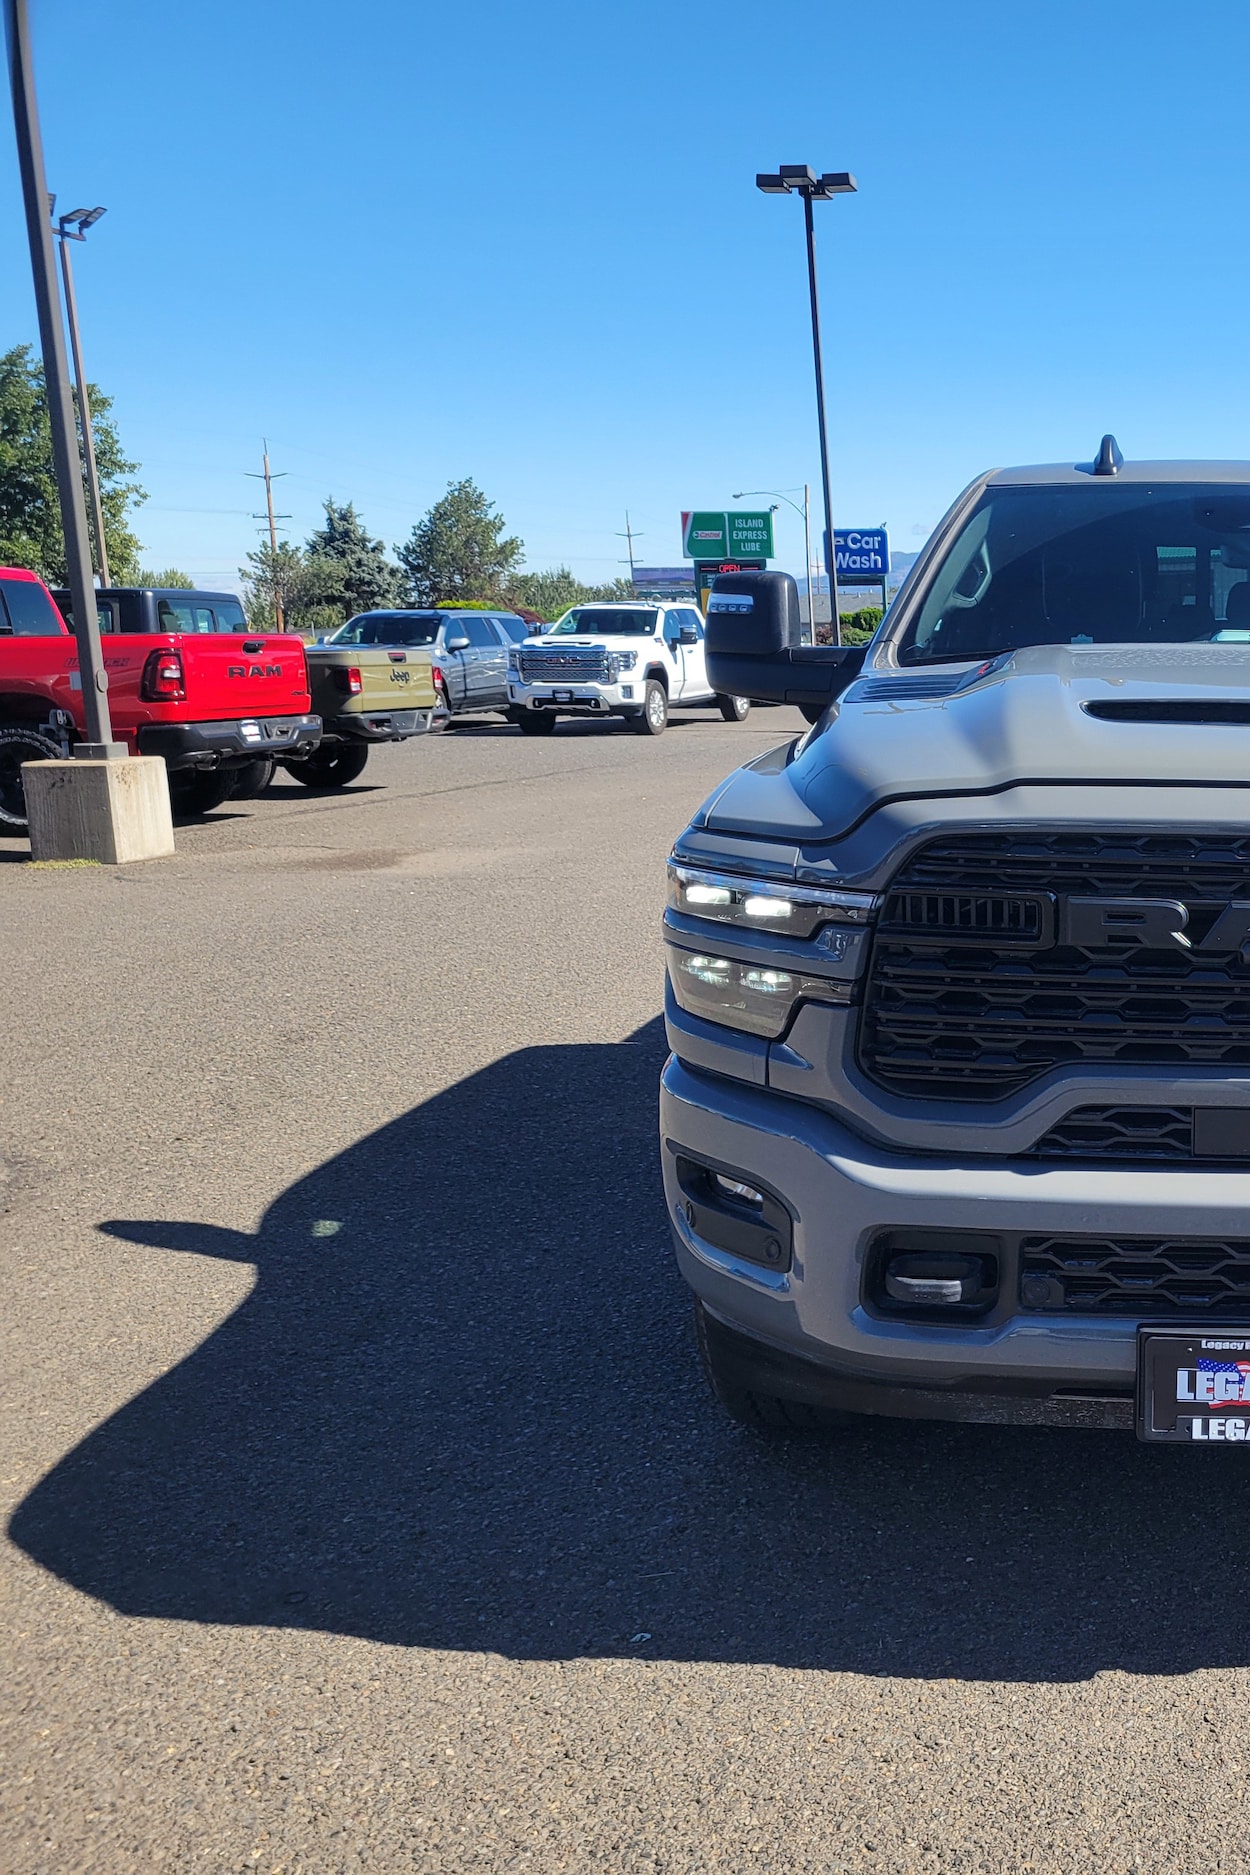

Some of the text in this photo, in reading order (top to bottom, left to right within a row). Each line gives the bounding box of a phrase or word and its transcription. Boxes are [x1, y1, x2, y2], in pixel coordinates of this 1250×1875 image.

[735, 518, 764, 528] ISLAND
[732, 530, 768, 540] EXPRESS
[846, 532, 882, 550] Car
[740, 542, 761, 552] LUBE
[835, 552, 882, 569] Wash
[718, 564, 741, 573] OPEN
[228, 665, 283, 679] RAM
[389, 668, 410, 685] Jeep
